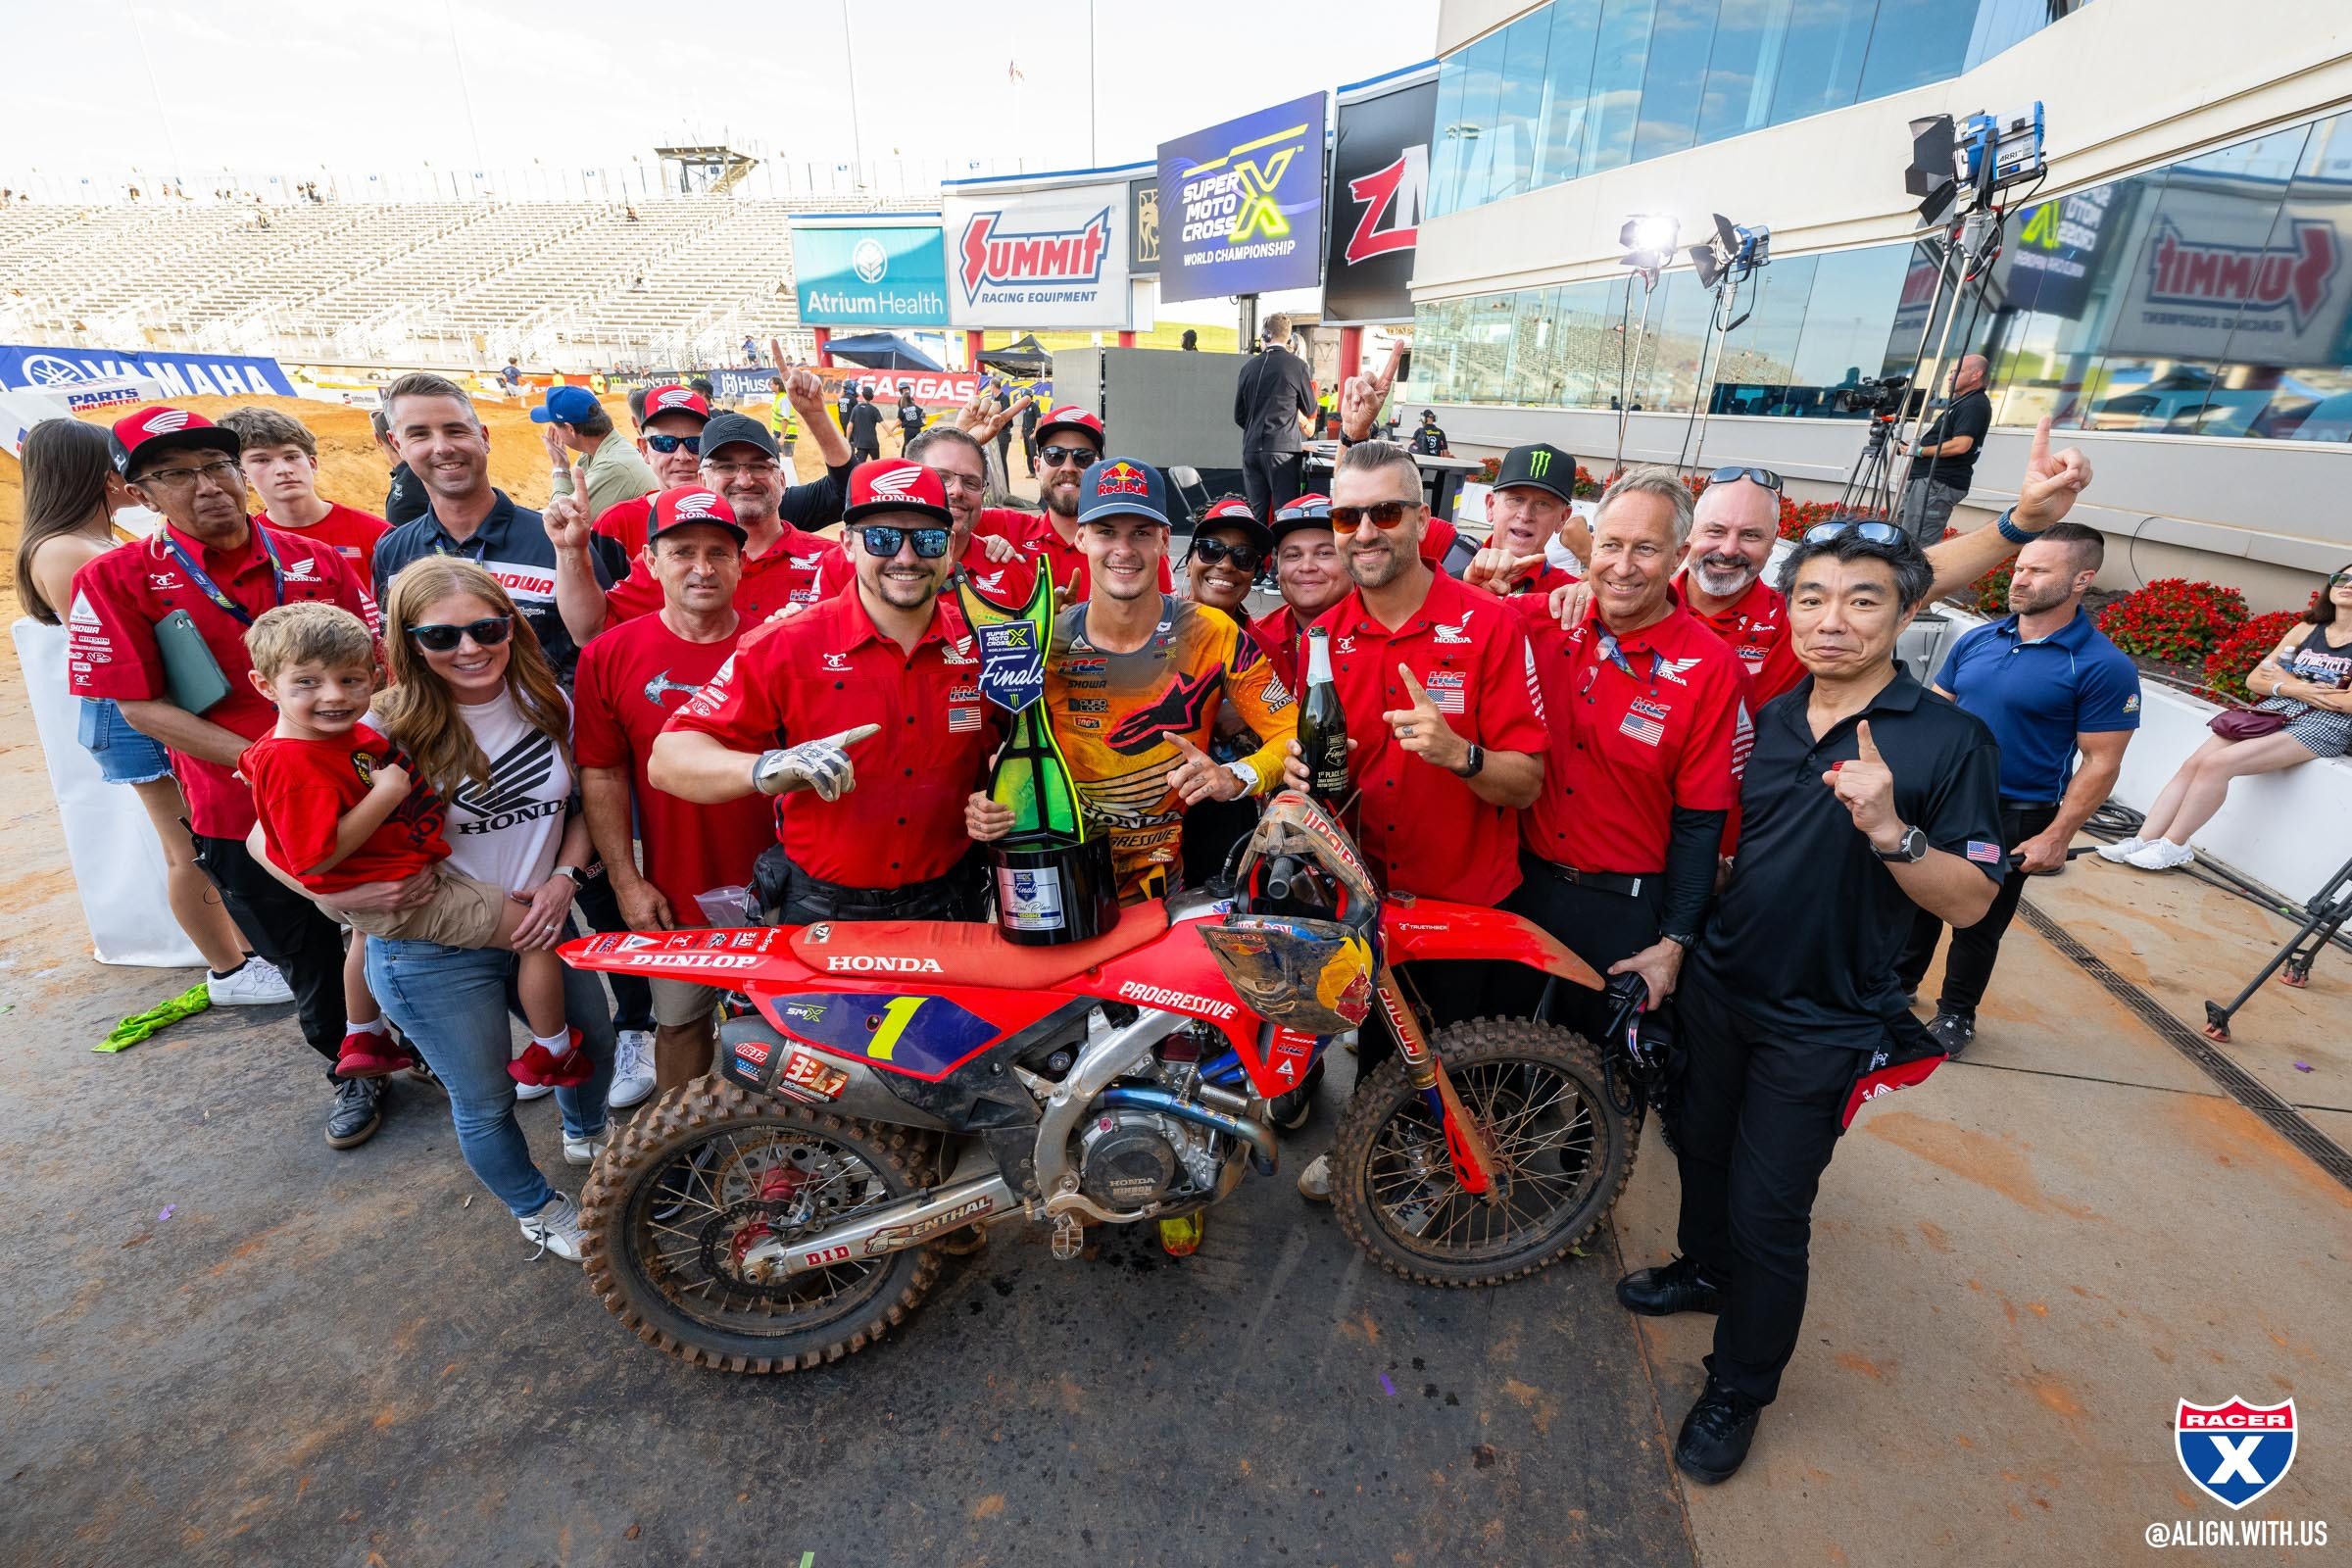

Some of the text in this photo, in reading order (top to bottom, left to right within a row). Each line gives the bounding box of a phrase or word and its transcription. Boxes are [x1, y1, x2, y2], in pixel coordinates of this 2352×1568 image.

[1998, 150, 2018, 163] ARRI
[1182, 171, 1240, 204] SUPER
[1186, 194, 1237, 222] MOTO
[1182, 215, 1238, 243] CROSS
[1184, 239, 1297, 267] WORLD CHAMPIONSHIP
[808, 290, 944, 315] Atrium Health
[981, 291, 1099, 304] RACING EQUIPMENT
[67, 388, 140, 406] PARTS
[71, 397, 141, 413] UNLIMITED
[1098, 481, 1149, 498] Red Bull
[870, 494, 926, 505] HONDA
[490, 572, 554, 595] HOWA
[976, 584, 1007, 595] HONDA
[977, 653, 1044, 691] Finals
[1058, 658, 1108, 673] HRC
[1068, 679, 1107, 688] SHOWA
[1427, 671, 1466, 685] HRC
[950, 685, 980, 699] HRC
[1630, 697, 1672, 716] HRC
[457, 796, 569, 835] HONDA
[1080, 802, 1184, 830] HONDA
[1112, 829, 1177, 848] GRESSIVE
[1409, 921, 1449, 930] TRUETIMBER
[626, 954, 758, 969] DUNLOP
[827, 956, 944, 973] HONDA
[1118, 980, 1239, 1020] PROGRESSIVE
[786, 1006, 825, 1023] SMX
[866, 996, 930, 1061] 1
[1109, 1177, 1156, 1187] HONDA
[806, 1245, 851, 1267] D.I.D
